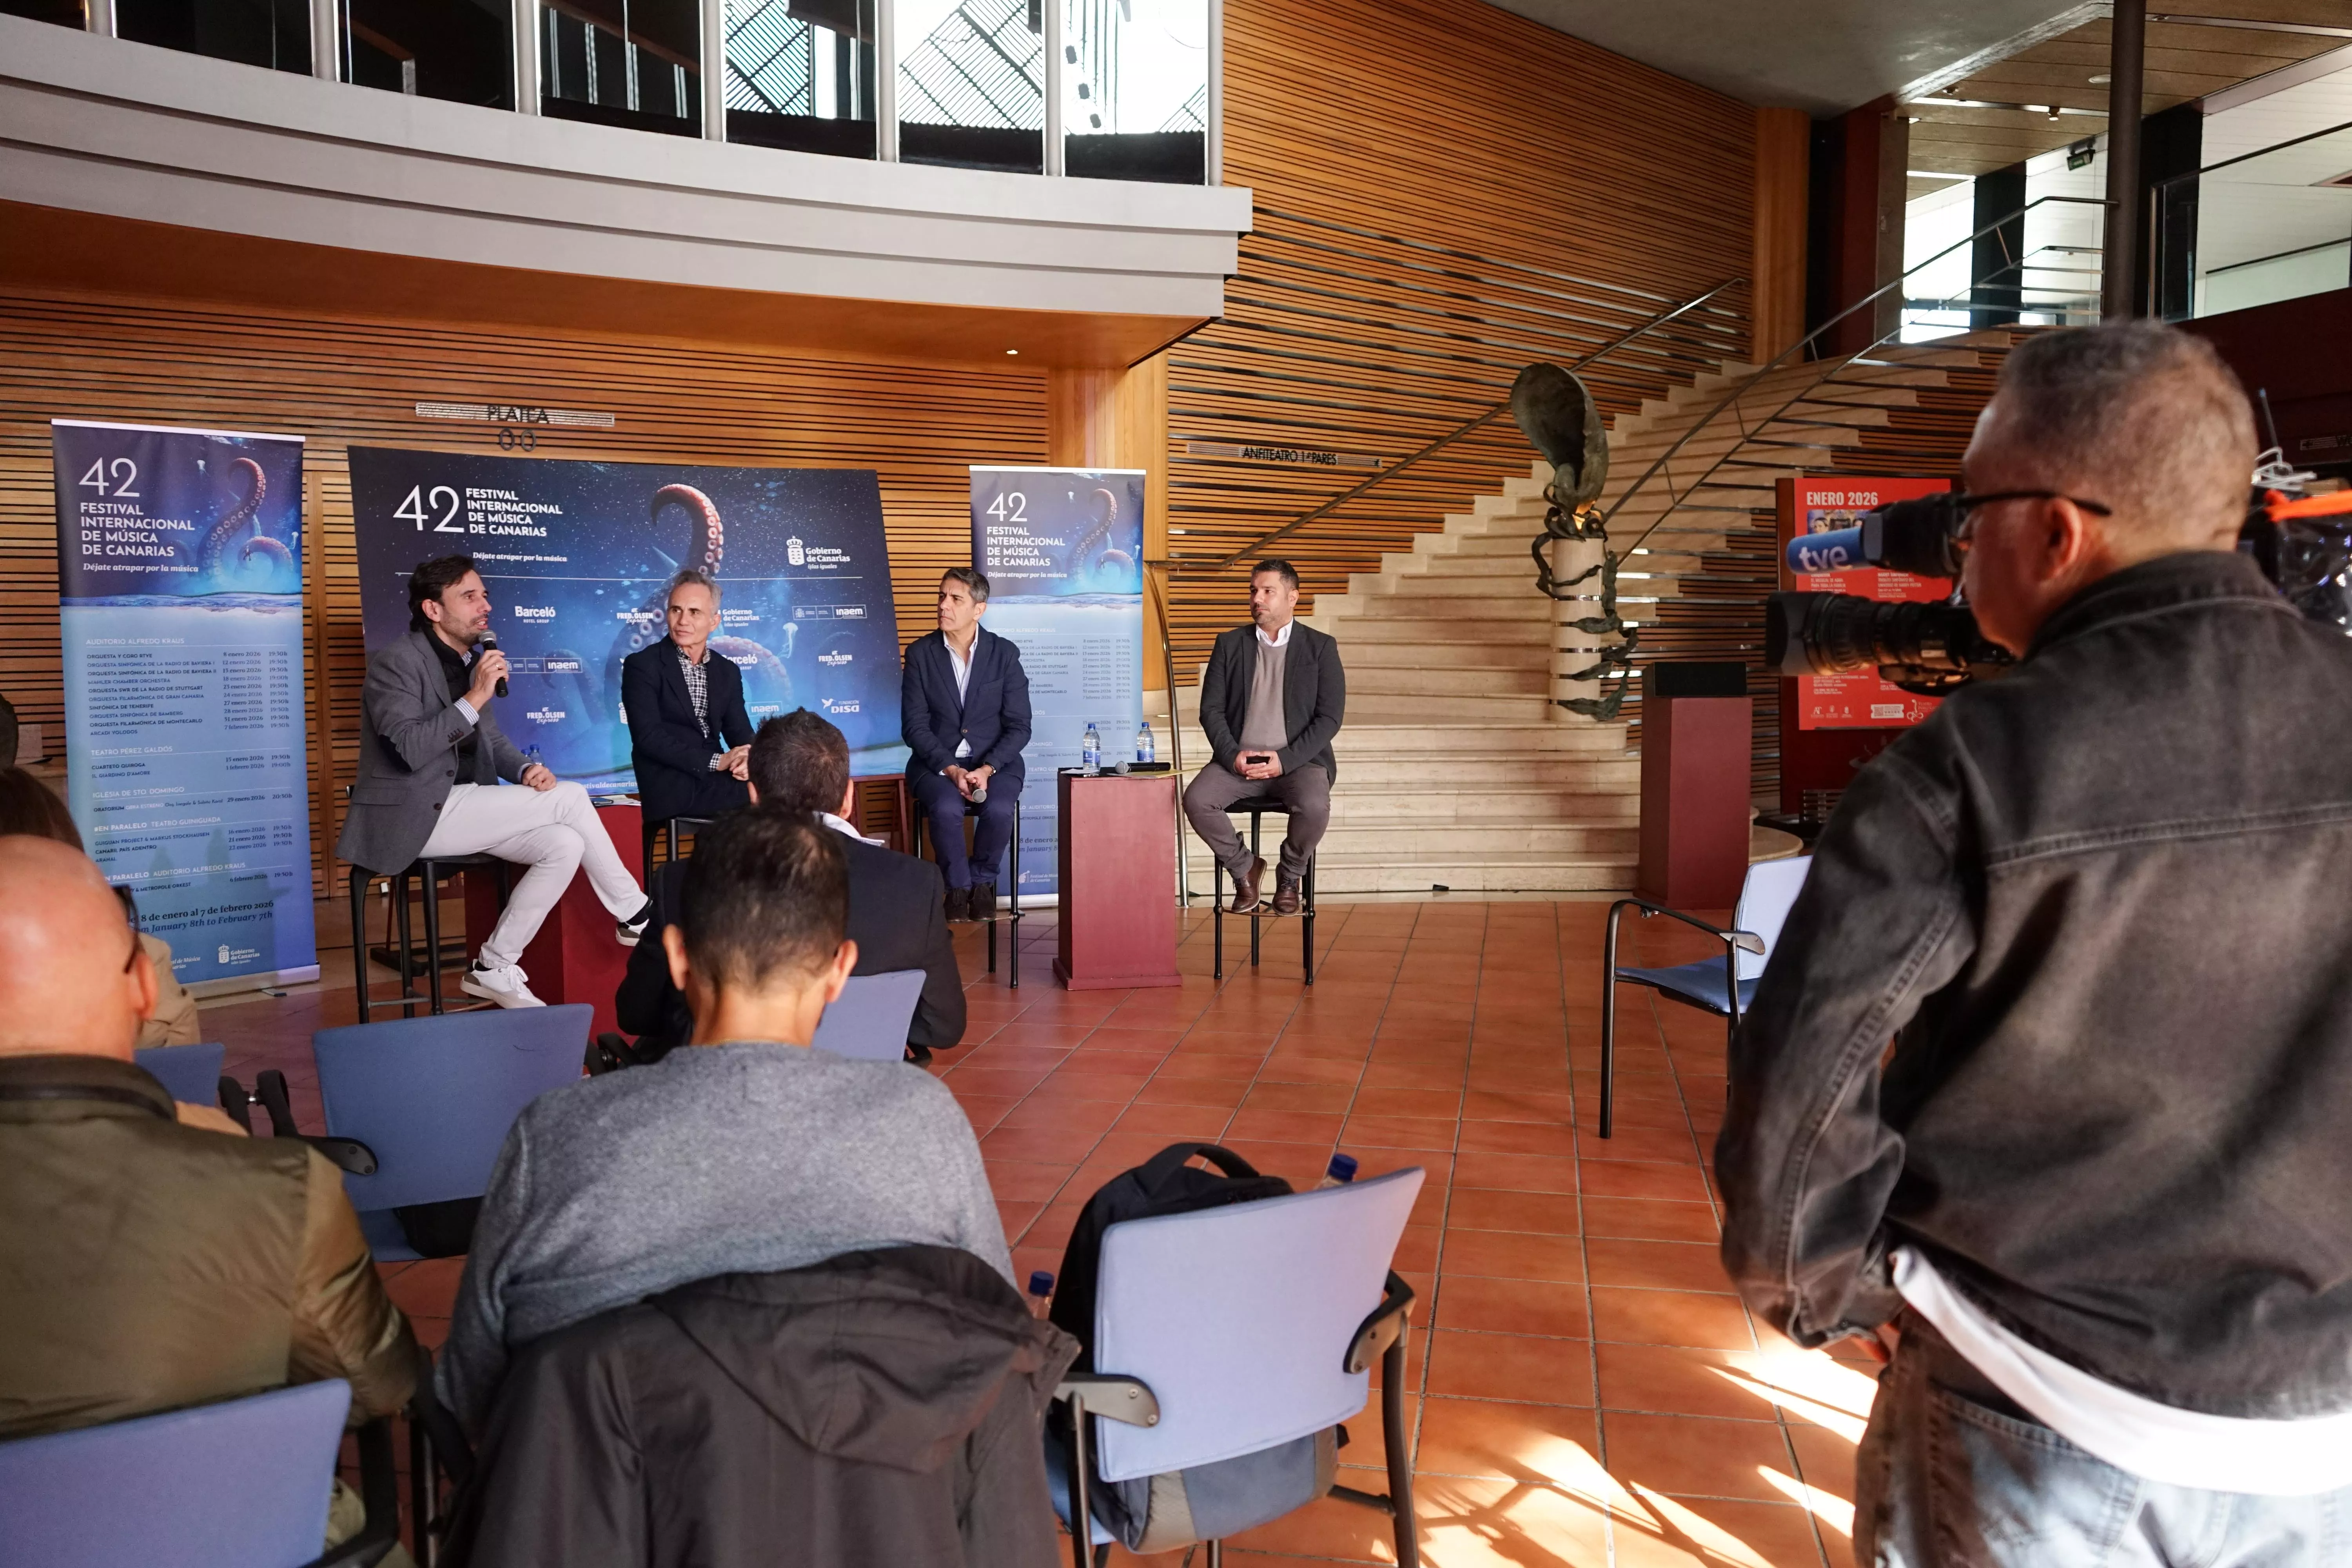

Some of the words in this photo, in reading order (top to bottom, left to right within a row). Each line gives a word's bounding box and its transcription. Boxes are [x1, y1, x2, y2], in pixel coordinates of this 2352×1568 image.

[488, 405, 549, 424] PLATEA
[1243, 446, 1298, 462] ANFITEATRO
[79, 457, 140, 497] 42
[466, 488, 519, 500] FESTIVAL
[1807, 492, 1844, 506] ENERO
[1848, 492, 1878, 506] 2026
[80, 503, 144, 515] FESTIVAL
[392, 484, 464, 533] 42
[467, 500, 563, 514] INTERNACIONAL
[986, 492, 1027, 522] 42
[81, 517, 195, 530] INTERNACIONAL
[468, 512, 485, 522] DE
[488, 512, 533, 524] MÚSICA
[82, 530, 101, 541] DE
[106, 530, 158, 543] MÚSICA
[470, 524, 486, 534] DE
[489, 525, 547, 537] CANARIAS
[987, 526, 1029, 535] FESTIVAL
[987, 537, 1065, 546] INTERNACIONAL
[82, 544, 102, 555] DE
[106, 545, 174, 557] CANARIAS
[473, 552, 495, 560] Déjate
[987, 547, 1000, 555] DE
[1004, 546, 1039, 555] MÚSICA
[987, 557, 1000, 566] DE
[1003, 558, 1051, 566] CANARIAS
[1799, 546, 1853, 571] tve
[83, 563, 111, 572] Déjate
[515, 606, 556, 617] Barceló
[721, 654, 757, 664] rceló
[180, 817, 221, 826] GUINIGUADA
[113, 872, 149, 880] PARALELO
[153, 868, 191, 877] AUDITORIO
[192, 865, 223, 873] ALFREDO
[162, 911, 188, 920] enero
[220, 904, 252, 913] febrero
[254, 900, 274, 908] 2026
[151, 922, 188, 933] January
[218, 913, 257, 924] February
[259, 911, 272, 921] 7th
